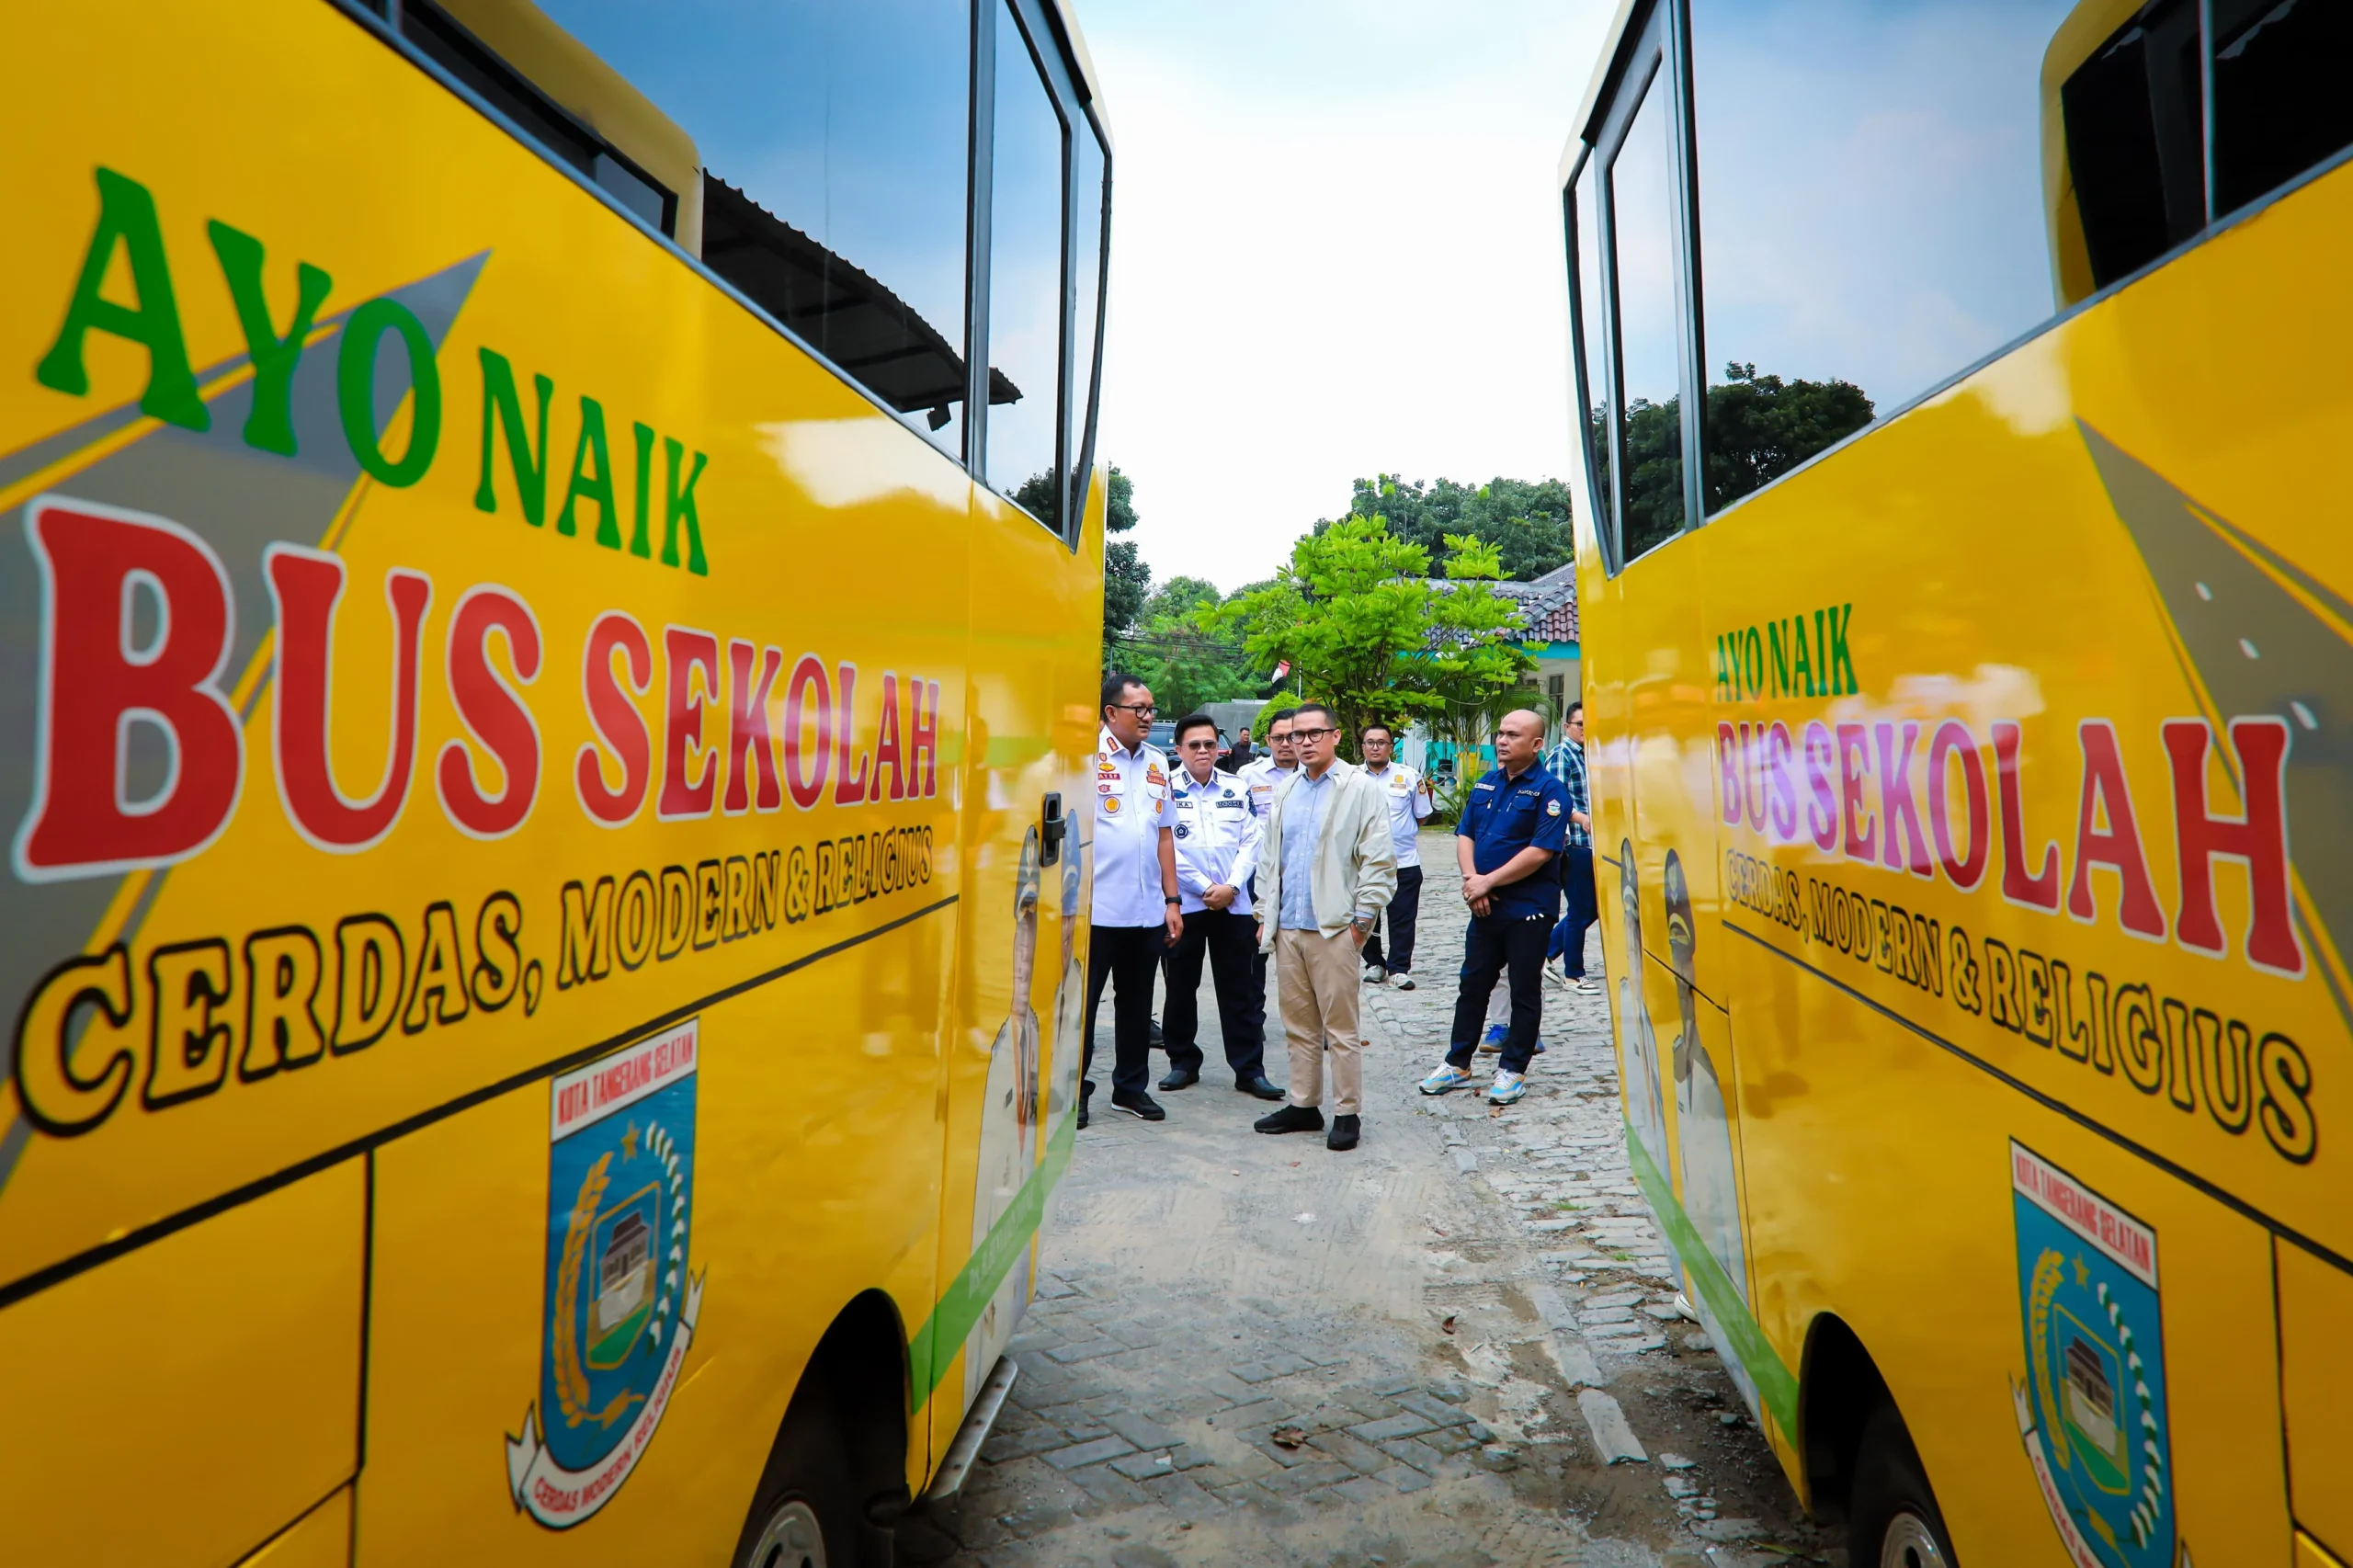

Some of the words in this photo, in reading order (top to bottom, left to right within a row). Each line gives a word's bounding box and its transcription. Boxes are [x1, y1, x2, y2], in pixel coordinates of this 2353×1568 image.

[35, 165, 442, 488] AYO
[474, 346, 710, 577] NAIK
[11, 494, 544, 883] BUS
[573, 608, 941, 831] SEKOLAH
[1717, 626, 1763, 702] AYO
[1768, 603, 1859, 699] NAIK
[11, 890, 544, 1138] CERDAS,
[556, 850, 779, 991] MODERN
[784, 846, 810, 924] &
[813, 825, 934, 916] RELIGIUS
[1716, 719, 1797, 842] BUS
[1803, 715, 2307, 982] SEKOLAH
[1726, 847, 1809, 945] CERDAS,
[1809, 878, 1944, 997] MODERN
[1949, 926, 1981, 1015] &
[1984, 938, 2317, 1165] RELIGIUS
